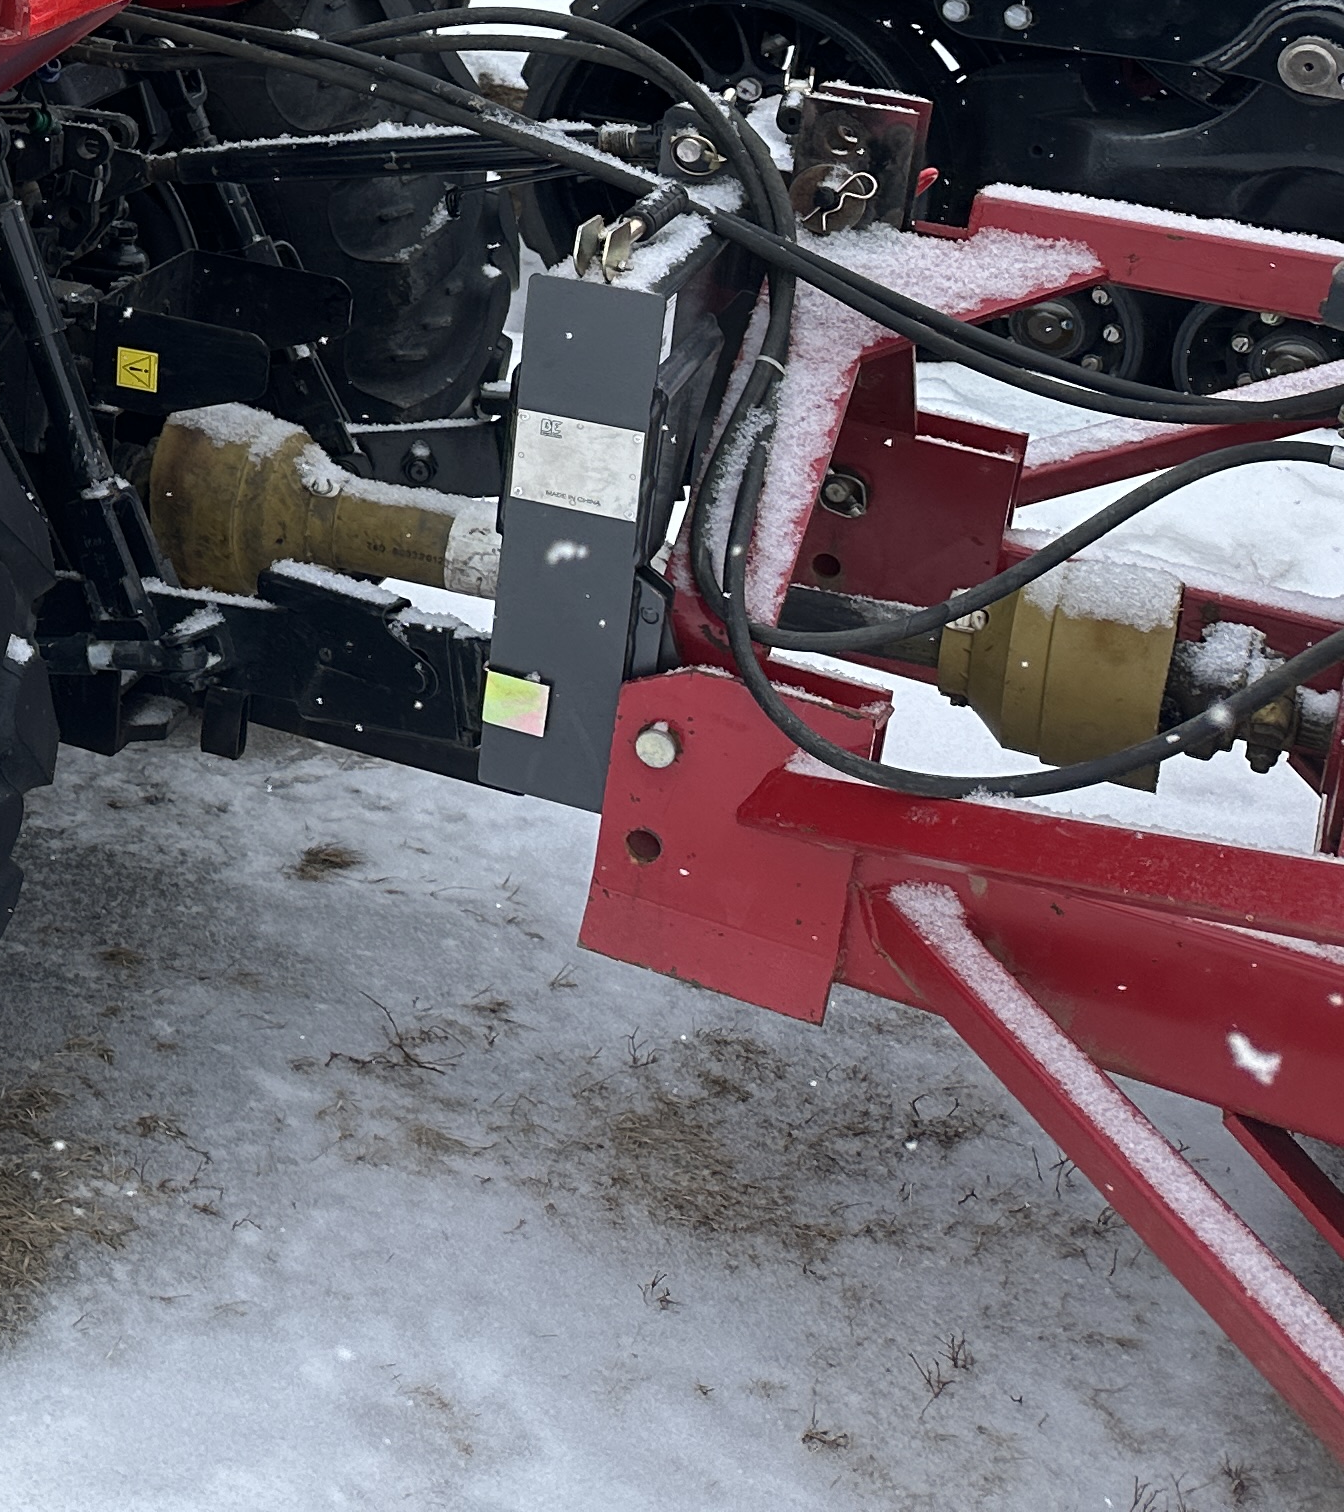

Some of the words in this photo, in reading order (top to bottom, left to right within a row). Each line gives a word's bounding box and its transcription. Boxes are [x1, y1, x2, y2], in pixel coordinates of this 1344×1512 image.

[545, 490, 566, 499] MADE
[568, 494, 576, 502] IN
[577, 496, 601, 507] CHINA
